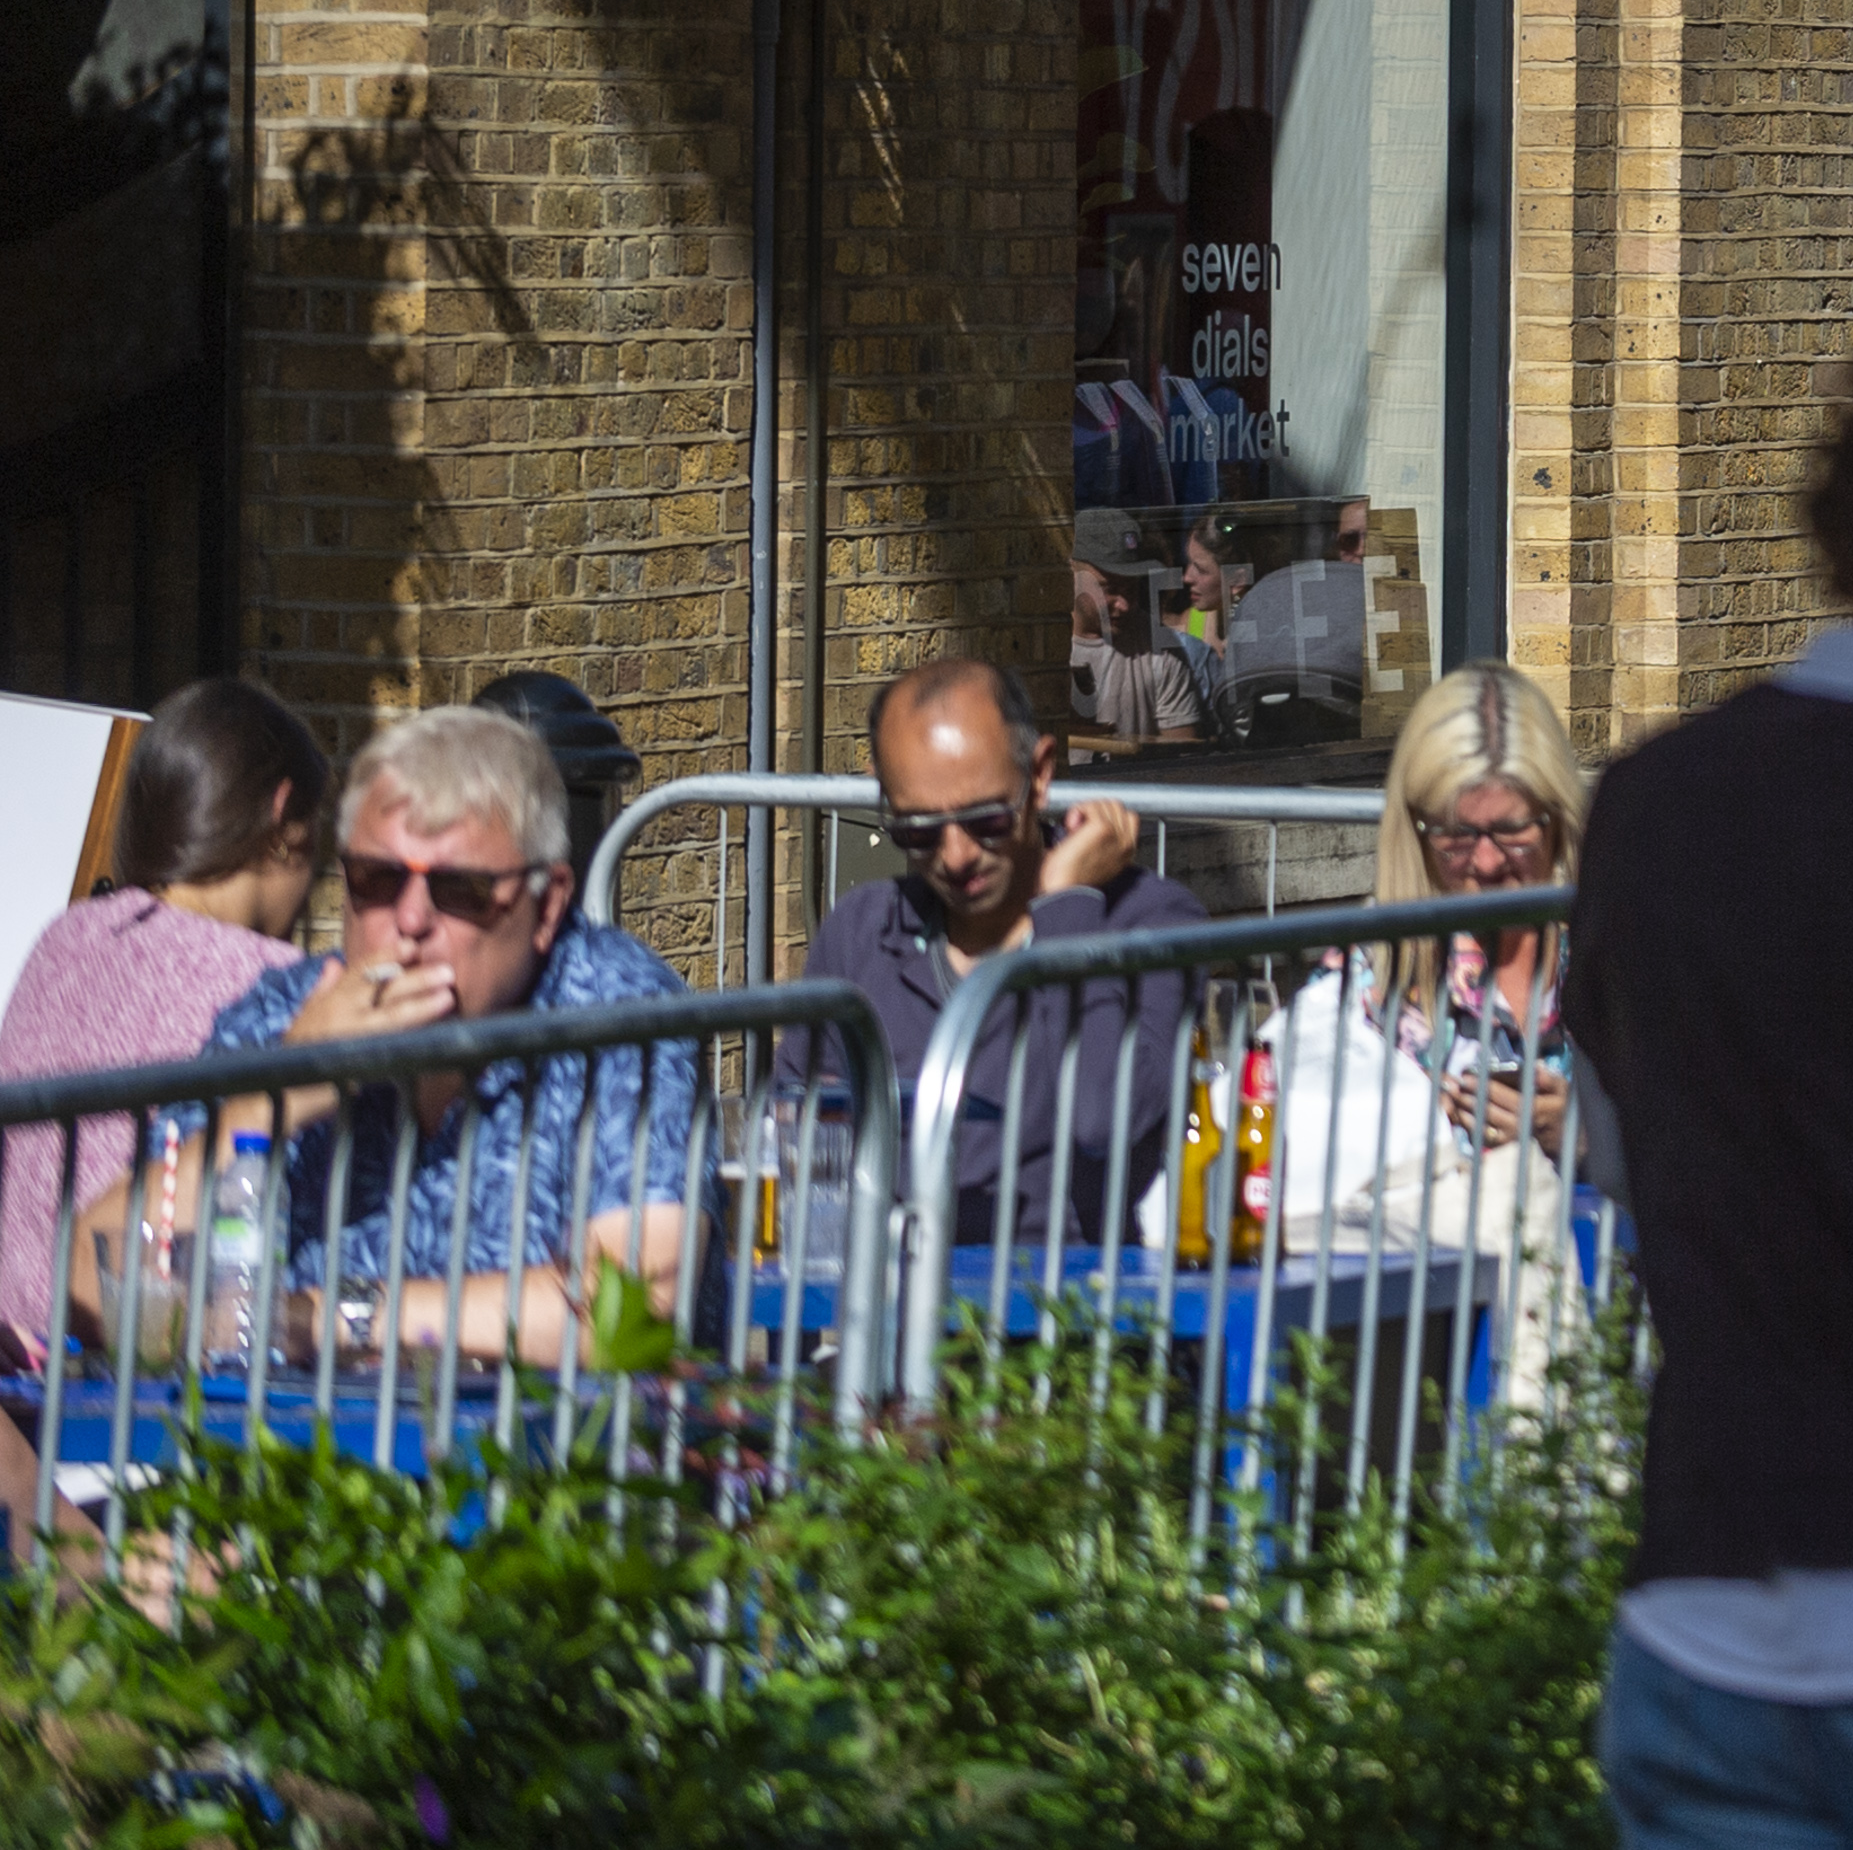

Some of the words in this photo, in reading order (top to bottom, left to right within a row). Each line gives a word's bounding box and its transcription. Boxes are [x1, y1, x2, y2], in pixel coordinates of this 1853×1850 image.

[1181, 239, 1282, 295] seven
[1193, 314, 1271, 379] dials
[1169, 399, 1290, 462] market
